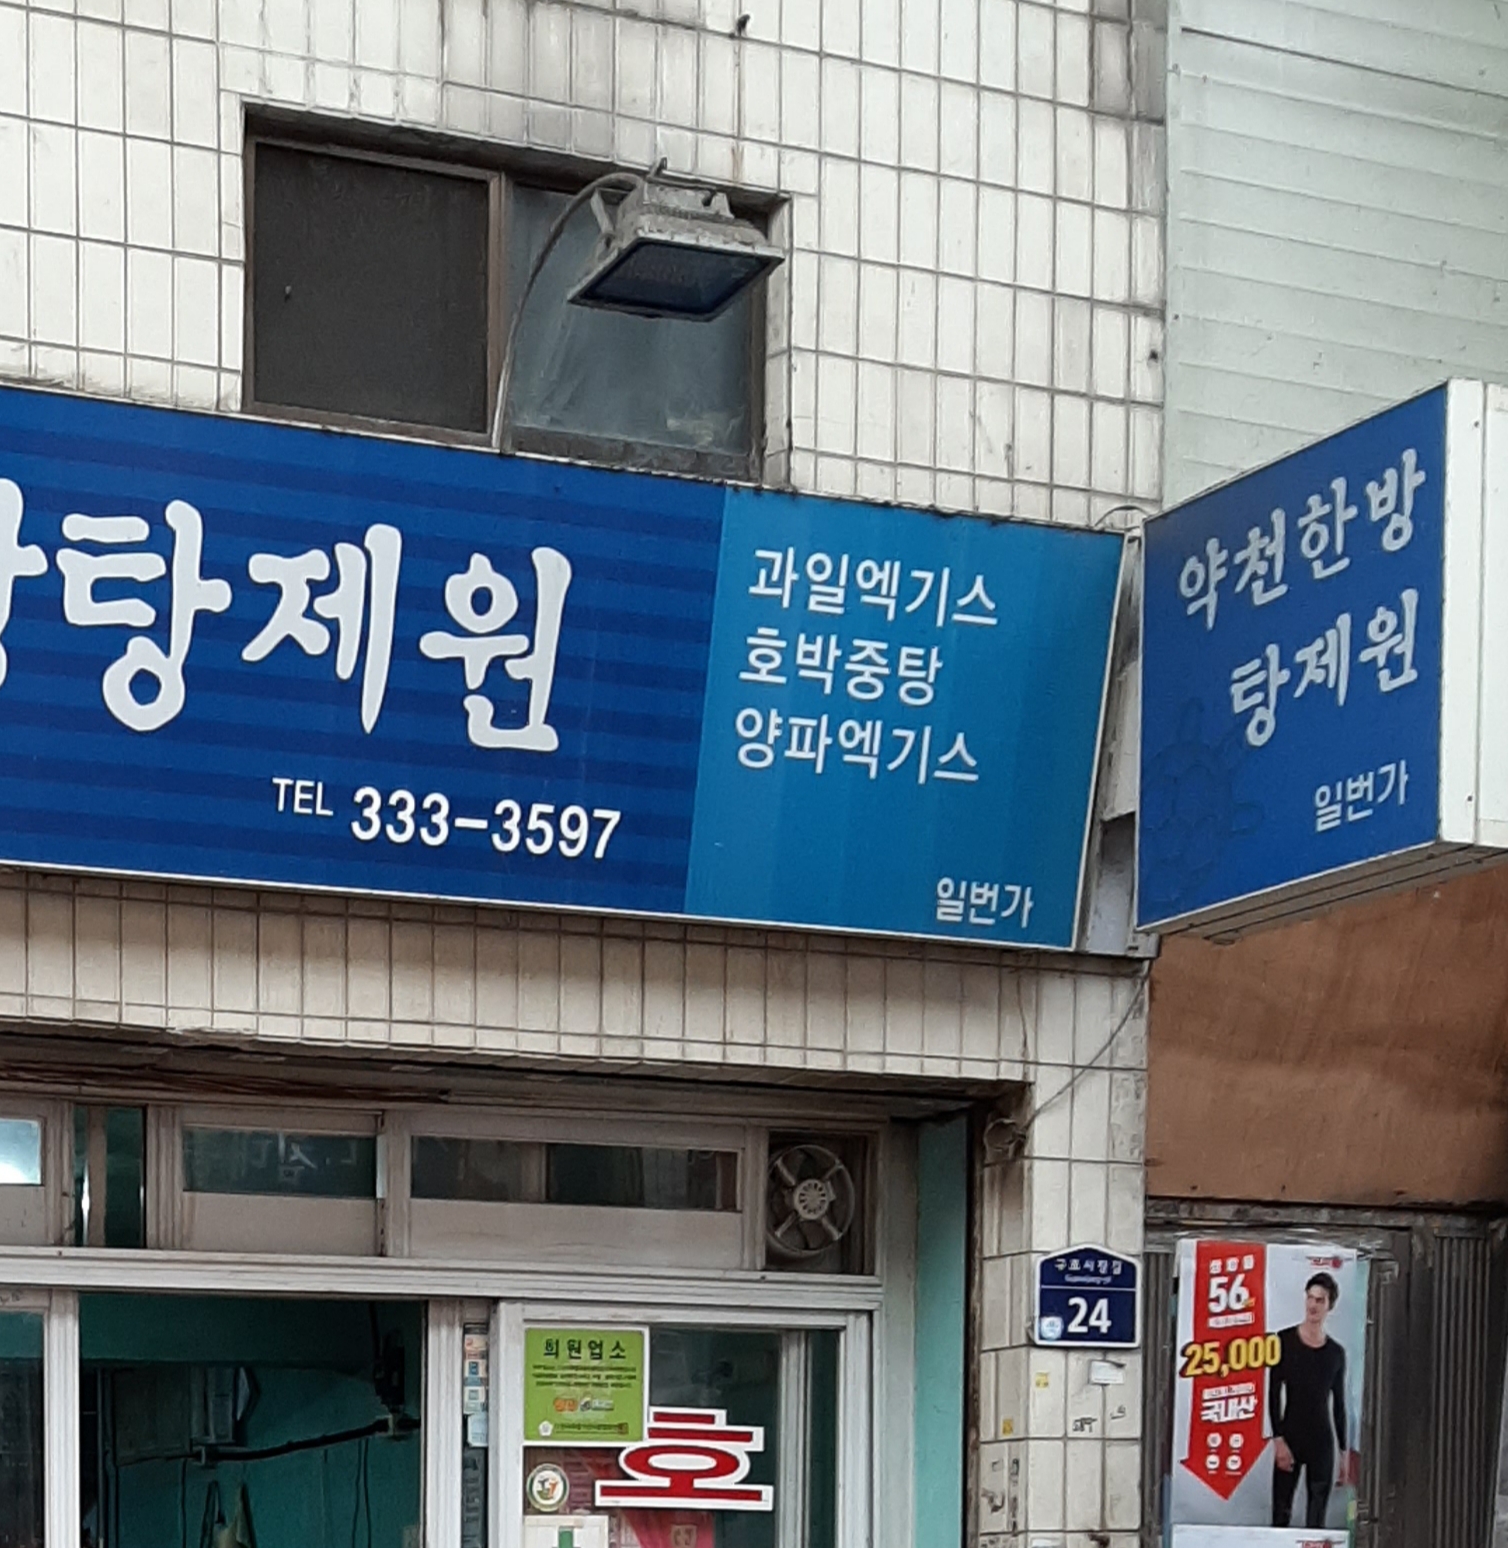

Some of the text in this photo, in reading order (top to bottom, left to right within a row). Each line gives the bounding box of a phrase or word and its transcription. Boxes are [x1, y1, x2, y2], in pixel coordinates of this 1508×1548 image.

[1178, 448, 1425, 631] 약천한방
[748, 547, 999, 629] 과일엑기스
[738, 627, 943, 707] 호박중탕
[1230, 590, 1420, 749] 탕제원
[735, 706, 980, 785] 양파엑기스
[272, 777, 622, 858] TEL 333-3597
[1315, 761, 1409, 833] 일번가
[936, 877, 1034, 929] 일번가
[1067, 1297, 1112, 1334] 24
[1208, 1273, 1250, 1313] 56
[1180, 1334, 1282, 1378] 25,000
